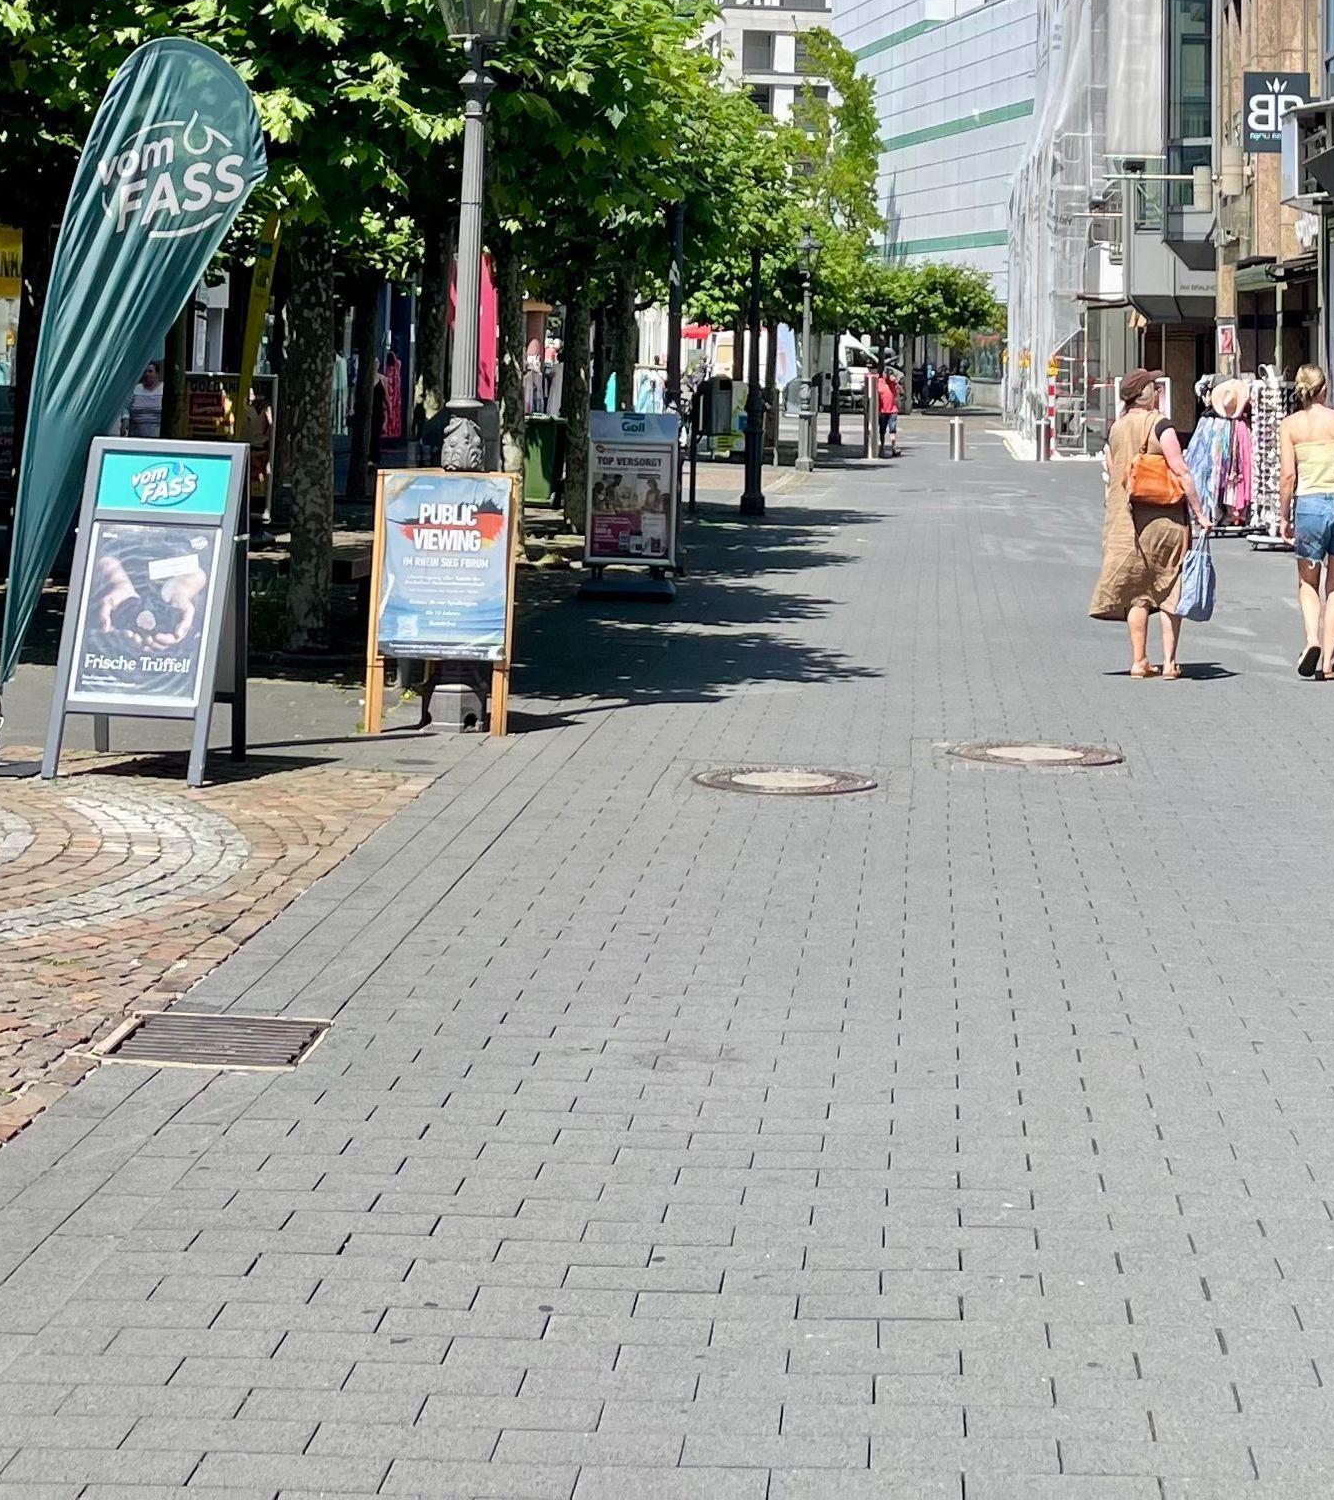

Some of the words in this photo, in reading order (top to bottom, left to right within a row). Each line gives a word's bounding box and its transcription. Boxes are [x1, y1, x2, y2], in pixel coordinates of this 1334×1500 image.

[98, 137, 174, 185] vom
[116, 154, 245, 233] FASS
[597, 456, 614, 466] TOP
[617, 457, 663, 468] VERSORGT
[131, 467, 169, 487] vom
[140, 473, 198, 504] FASS
[419, 503, 478, 527] PUBLIC
[412, 528, 482, 553] VIEWING
[402, 557, 414, 567] IM
[414, 557, 440, 568] RHEIN
[440, 558, 459, 568] SIEG
[460, 558, 489, 569] FORUM
[84, 653, 137, 671] Frische
[140, 656, 191, 674] Trüffel!
